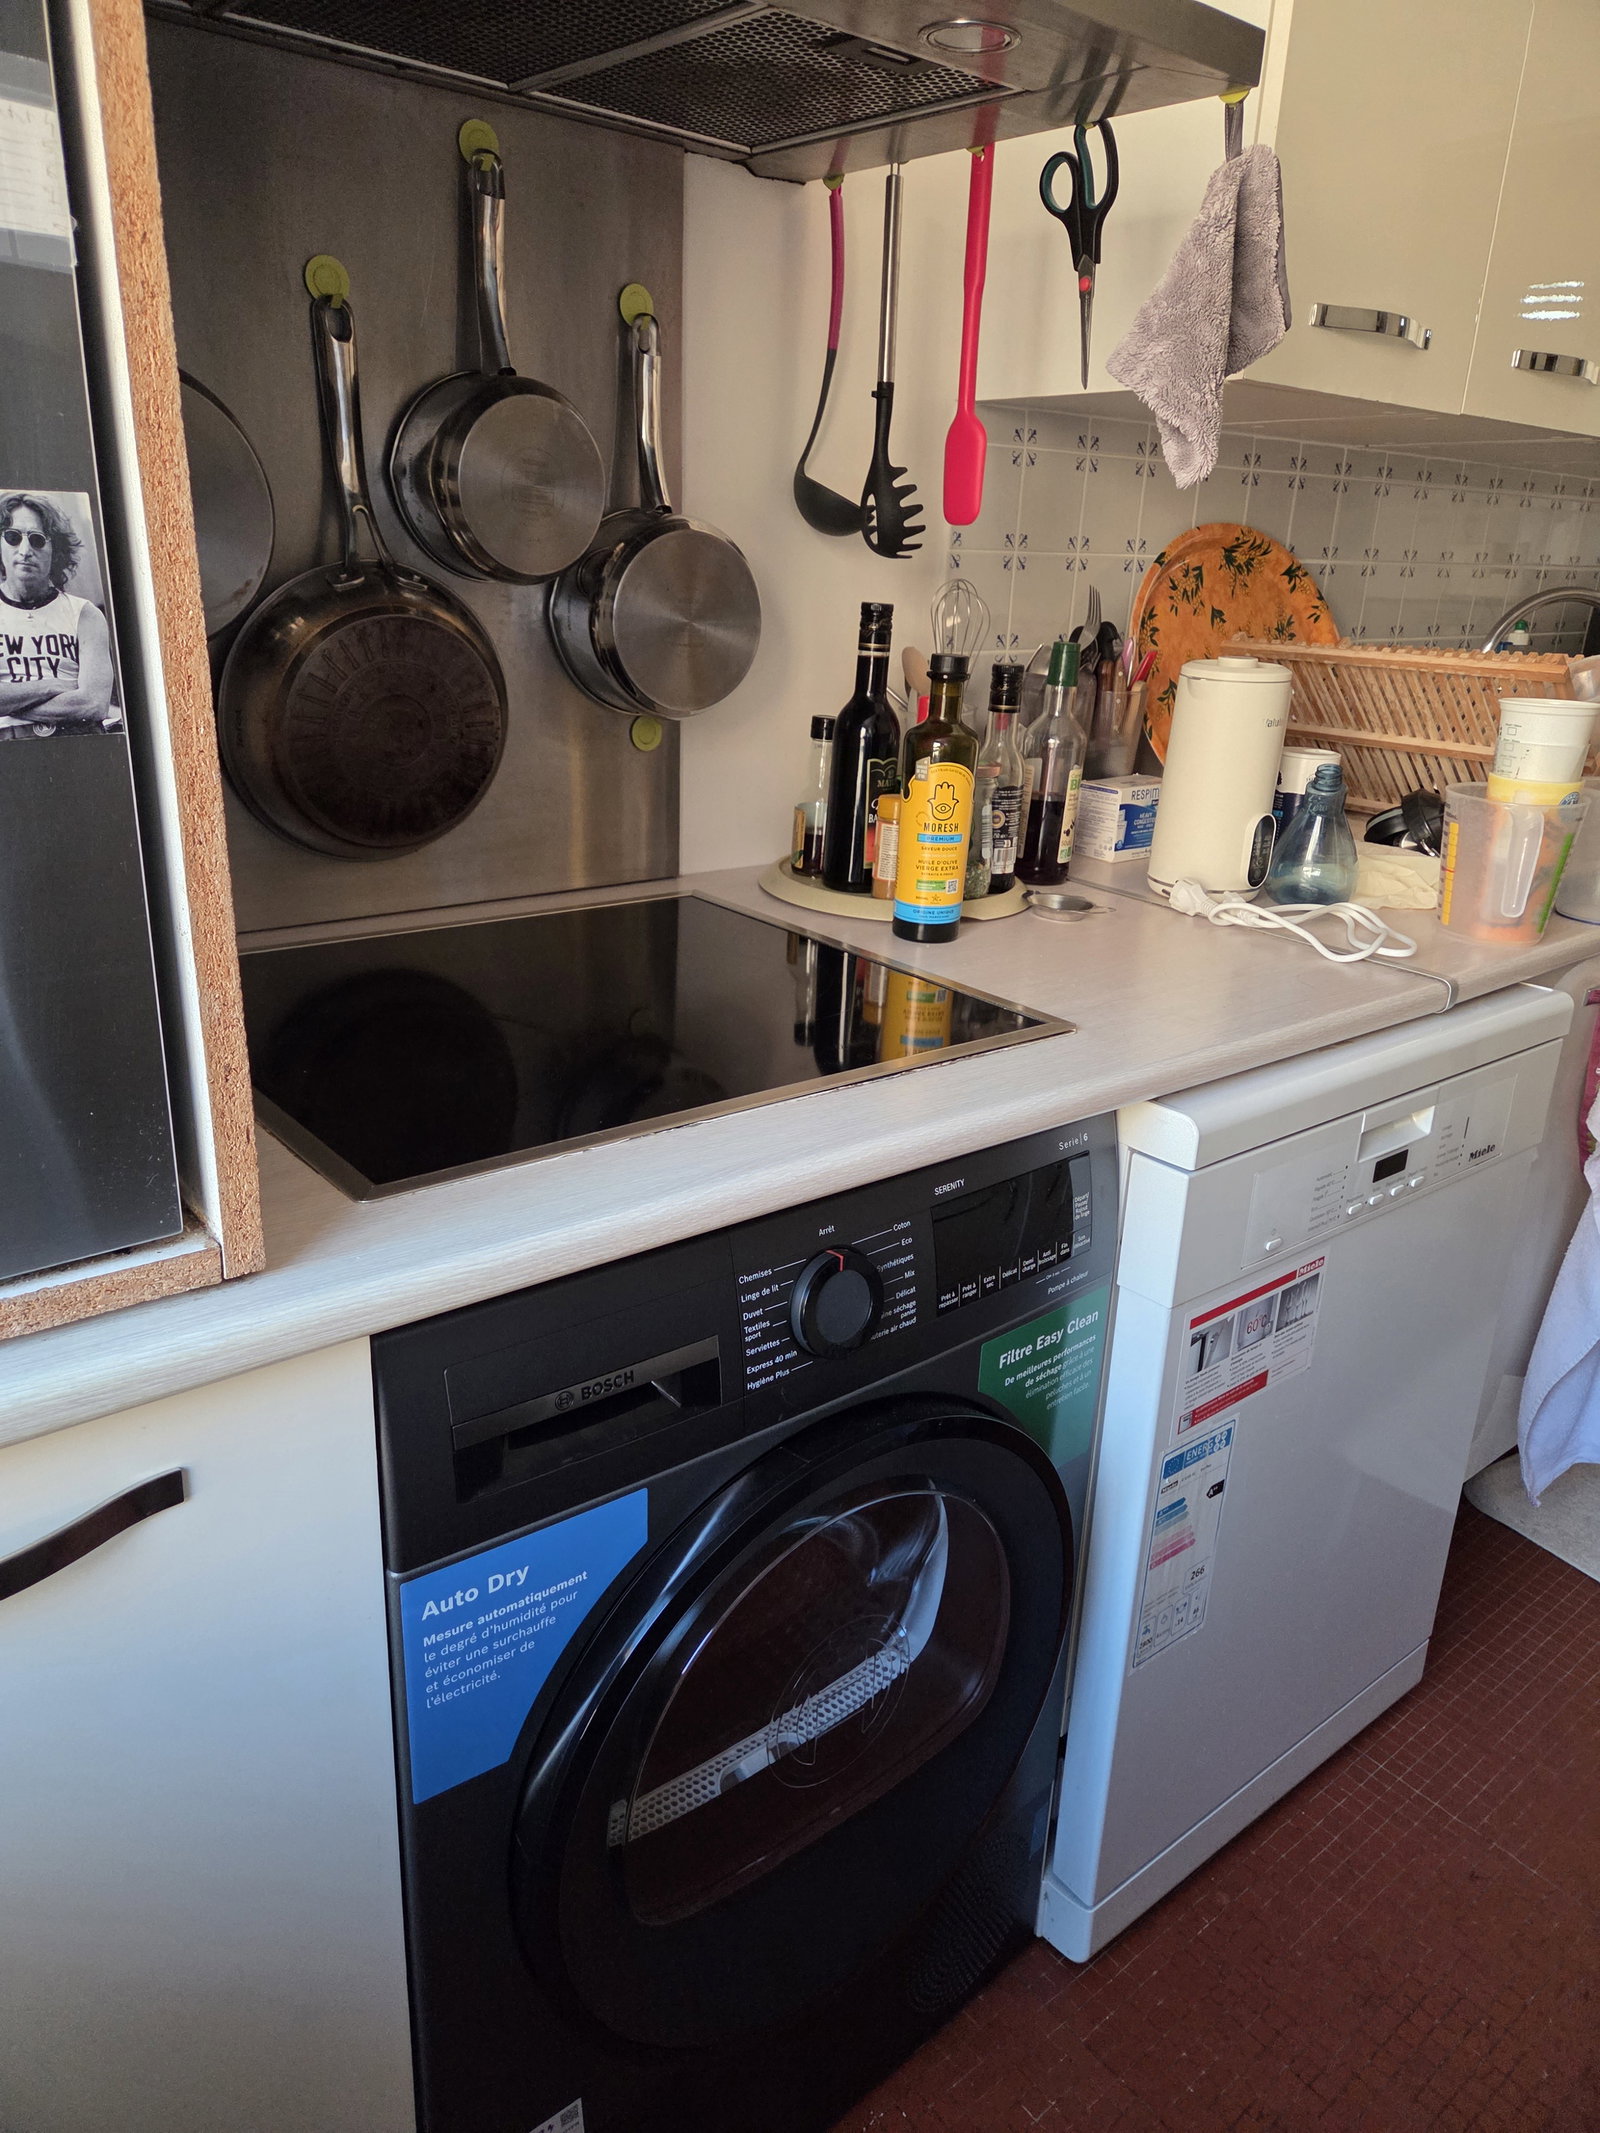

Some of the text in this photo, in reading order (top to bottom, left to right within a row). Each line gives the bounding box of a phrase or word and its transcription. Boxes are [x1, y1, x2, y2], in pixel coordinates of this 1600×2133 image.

[7, 656, 60, 683] CITY
[924, 822, 959, 832] MORESH
[916, 864, 938, 872] VIERGE
[1469, 1144, 1496, 1162] Miele
[934, 1179, 965, 1196] SERENITY
[893, 1220, 910, 1232] Coton
[902, 1237, 912, 1246] Eco
[877, 1254, 914, 1272] Synthétiques
[1298, 1259, 1324, 1276] Miele
[738, 1268, 772, 1284] Chemises
[904, 1270, 915, 1279] Mix
[1048, 1282, 1066, 1294] Pompe
[1070, 1270, 1088, 1284] chaleur
[741, 1290, 760, 1302] Linge
[762, 1288, 770, 1296] de
[896, 1286, 916, 1299] Délicat
[743, 1308, 763, 1320] Duvet
[894, 1301, 916, 1314] séchage
[900, 1308, 916, 1318] panier
[744, 1320, 770, 1334] Textiles
[890, 1324, 898, 1332] air
[899, 1316, 916, 1329] chaud
[1247, 1314, 1267, 1334] 60°C
[745, 1331, 762, 1342] sport
[1000, 1311, 1098, 1368] Filtre Easy Clean
[746, 1339, 780, 1356] Serviettes
[746, 1350, 798, 1374] Express 40 min
[1004, 1334, 1096, 1386] De meilleures performances
[581, 1370, 634, 1400] BOSCH
[747, 1369, 790, 1390] Hygiène Plus
[1025, 1378, 1034, 1388] de
[1036, 1364, 1062, 1382] séchage
[1026, 1376, 1058, 1398] élimination
[1060, 1364, 1082, 1380] efficace
[1046, 1380, 1072, 1400] peluches
[1046, 1390, 1072, 1410] entretien
[1186, 1440, 1213, 1460] ENERG
[1190, 1565, 1205, 1581] 266
[422, 1565, 529, 1621] Auto Dry
[424, 1570, 588, 1648] Mesure automatiquement
[424, 1591, 578, 1662] le degré d'humidité pour
[425, 1615, 556, 1678] éviter une surchauffe
[426, 1640, 535, 1694] et économiser de
[426, 1670, 501, 1709] l'électricité.
